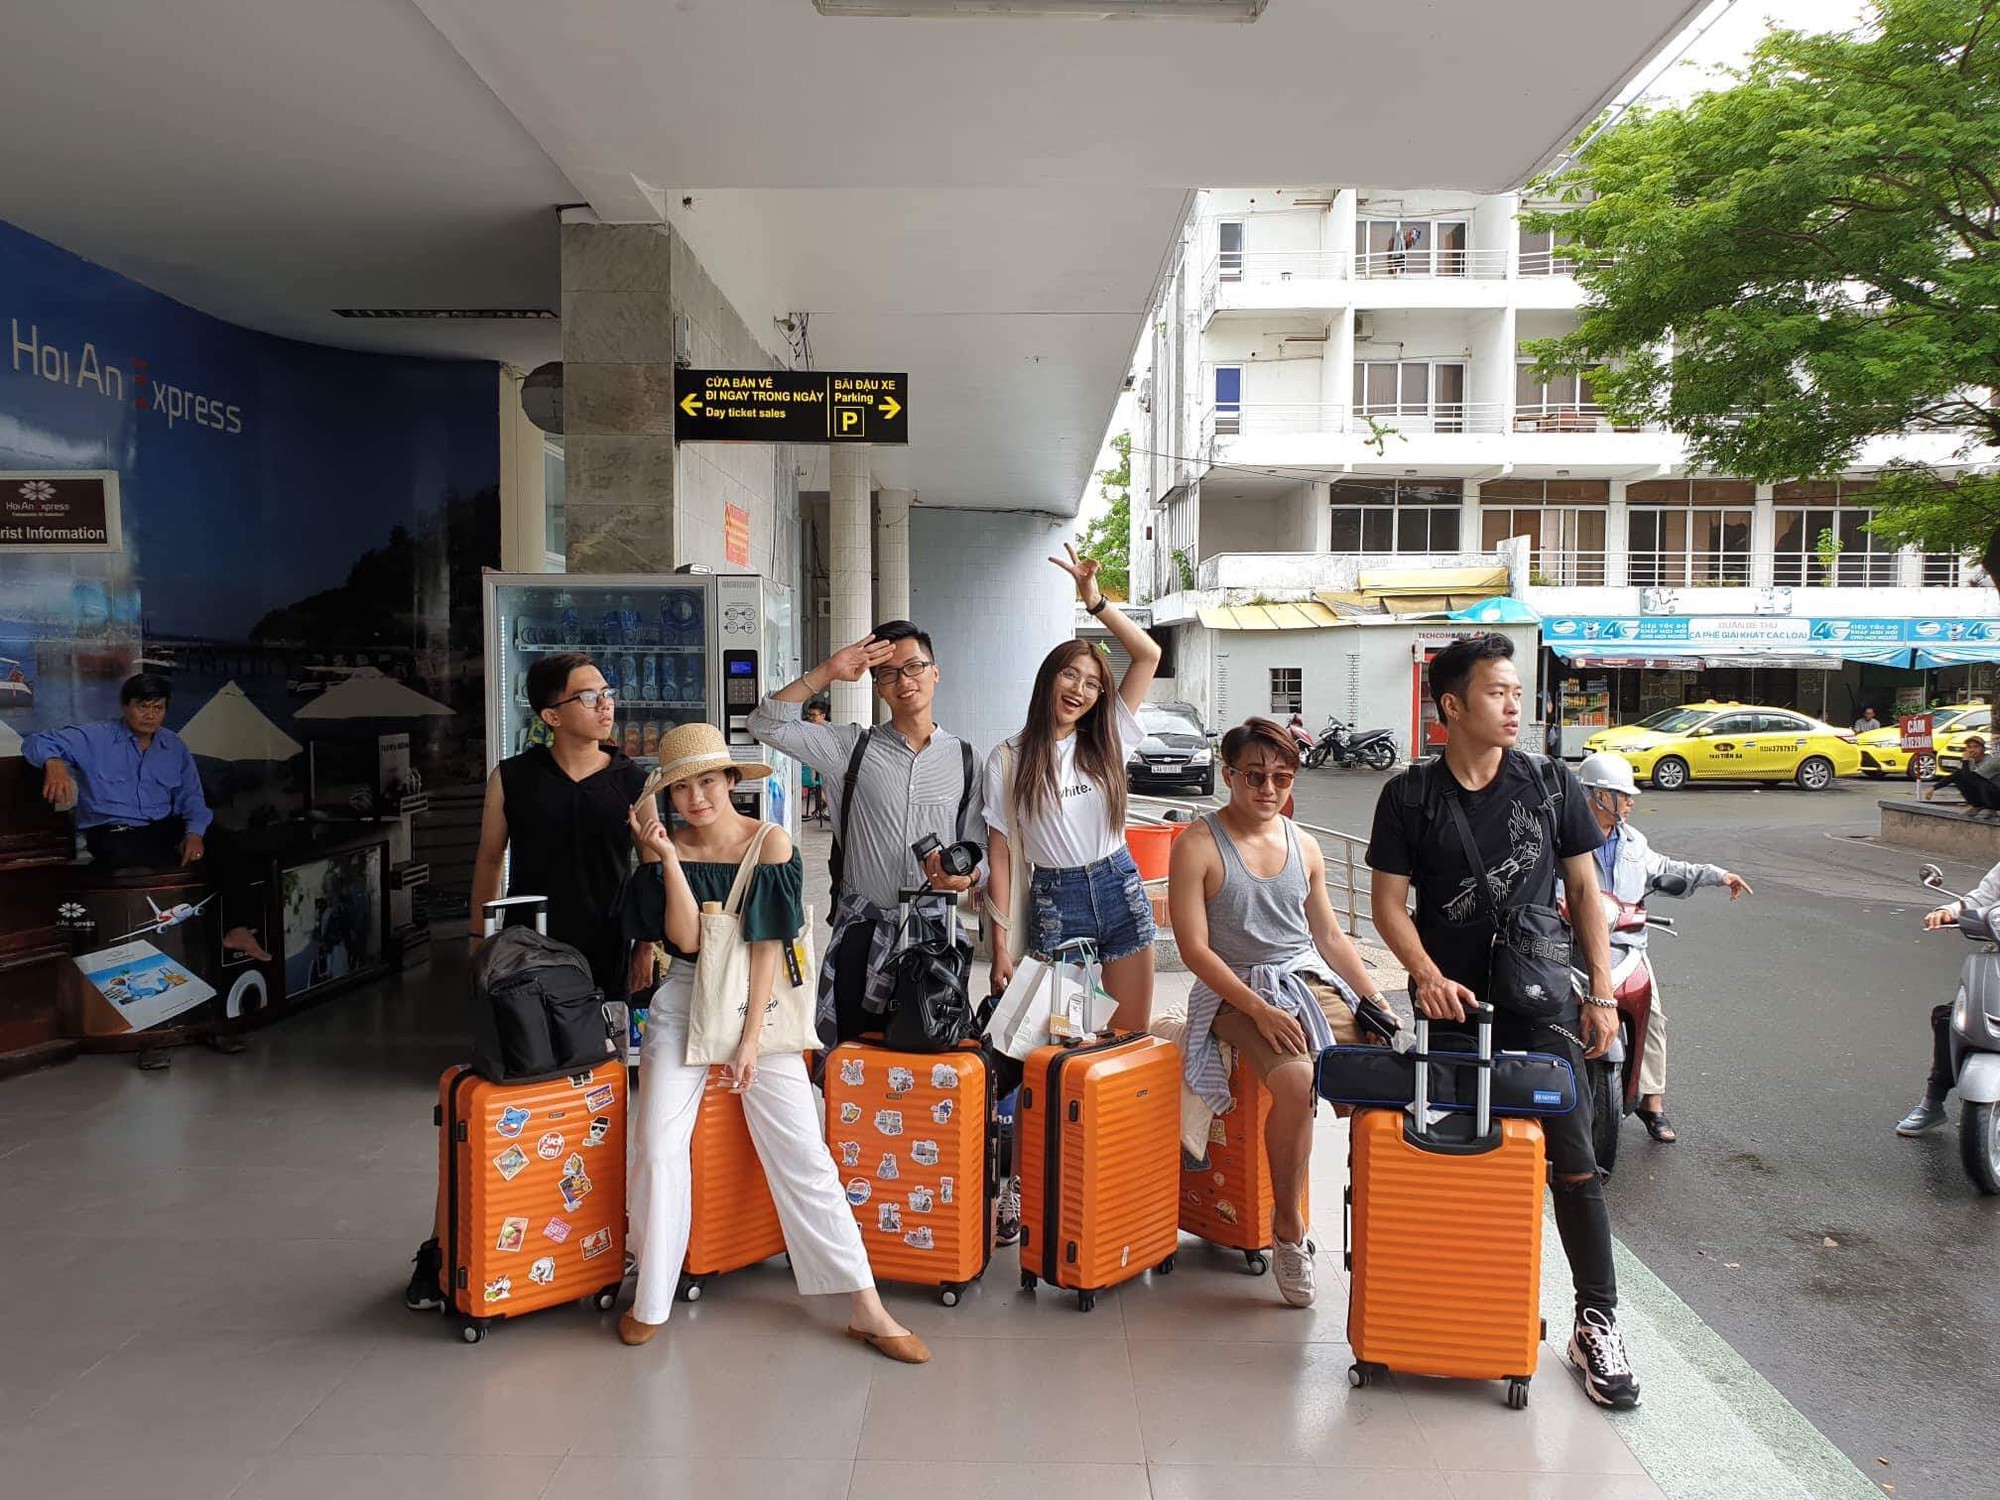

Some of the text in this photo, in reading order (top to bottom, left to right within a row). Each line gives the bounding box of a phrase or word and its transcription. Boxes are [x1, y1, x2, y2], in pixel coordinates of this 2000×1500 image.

[706, 375, 773, 388] CỬA BÁN VÉ
[835, 378, 853, 389] BÃI
[881, 380, 896, 390] XE
[706, 389, 824, 401] ĐI NGAY TRONG NGÀY
[835, 393, 873, 405] Parking
[706, 407, 786, 419] Day ticket sales
[842, 411, 858, 431] P
[26, 526, 104, 539] Information
[1602, 620, 1641, 640] 4G
[1812, 620, 1851, 640] 4G
